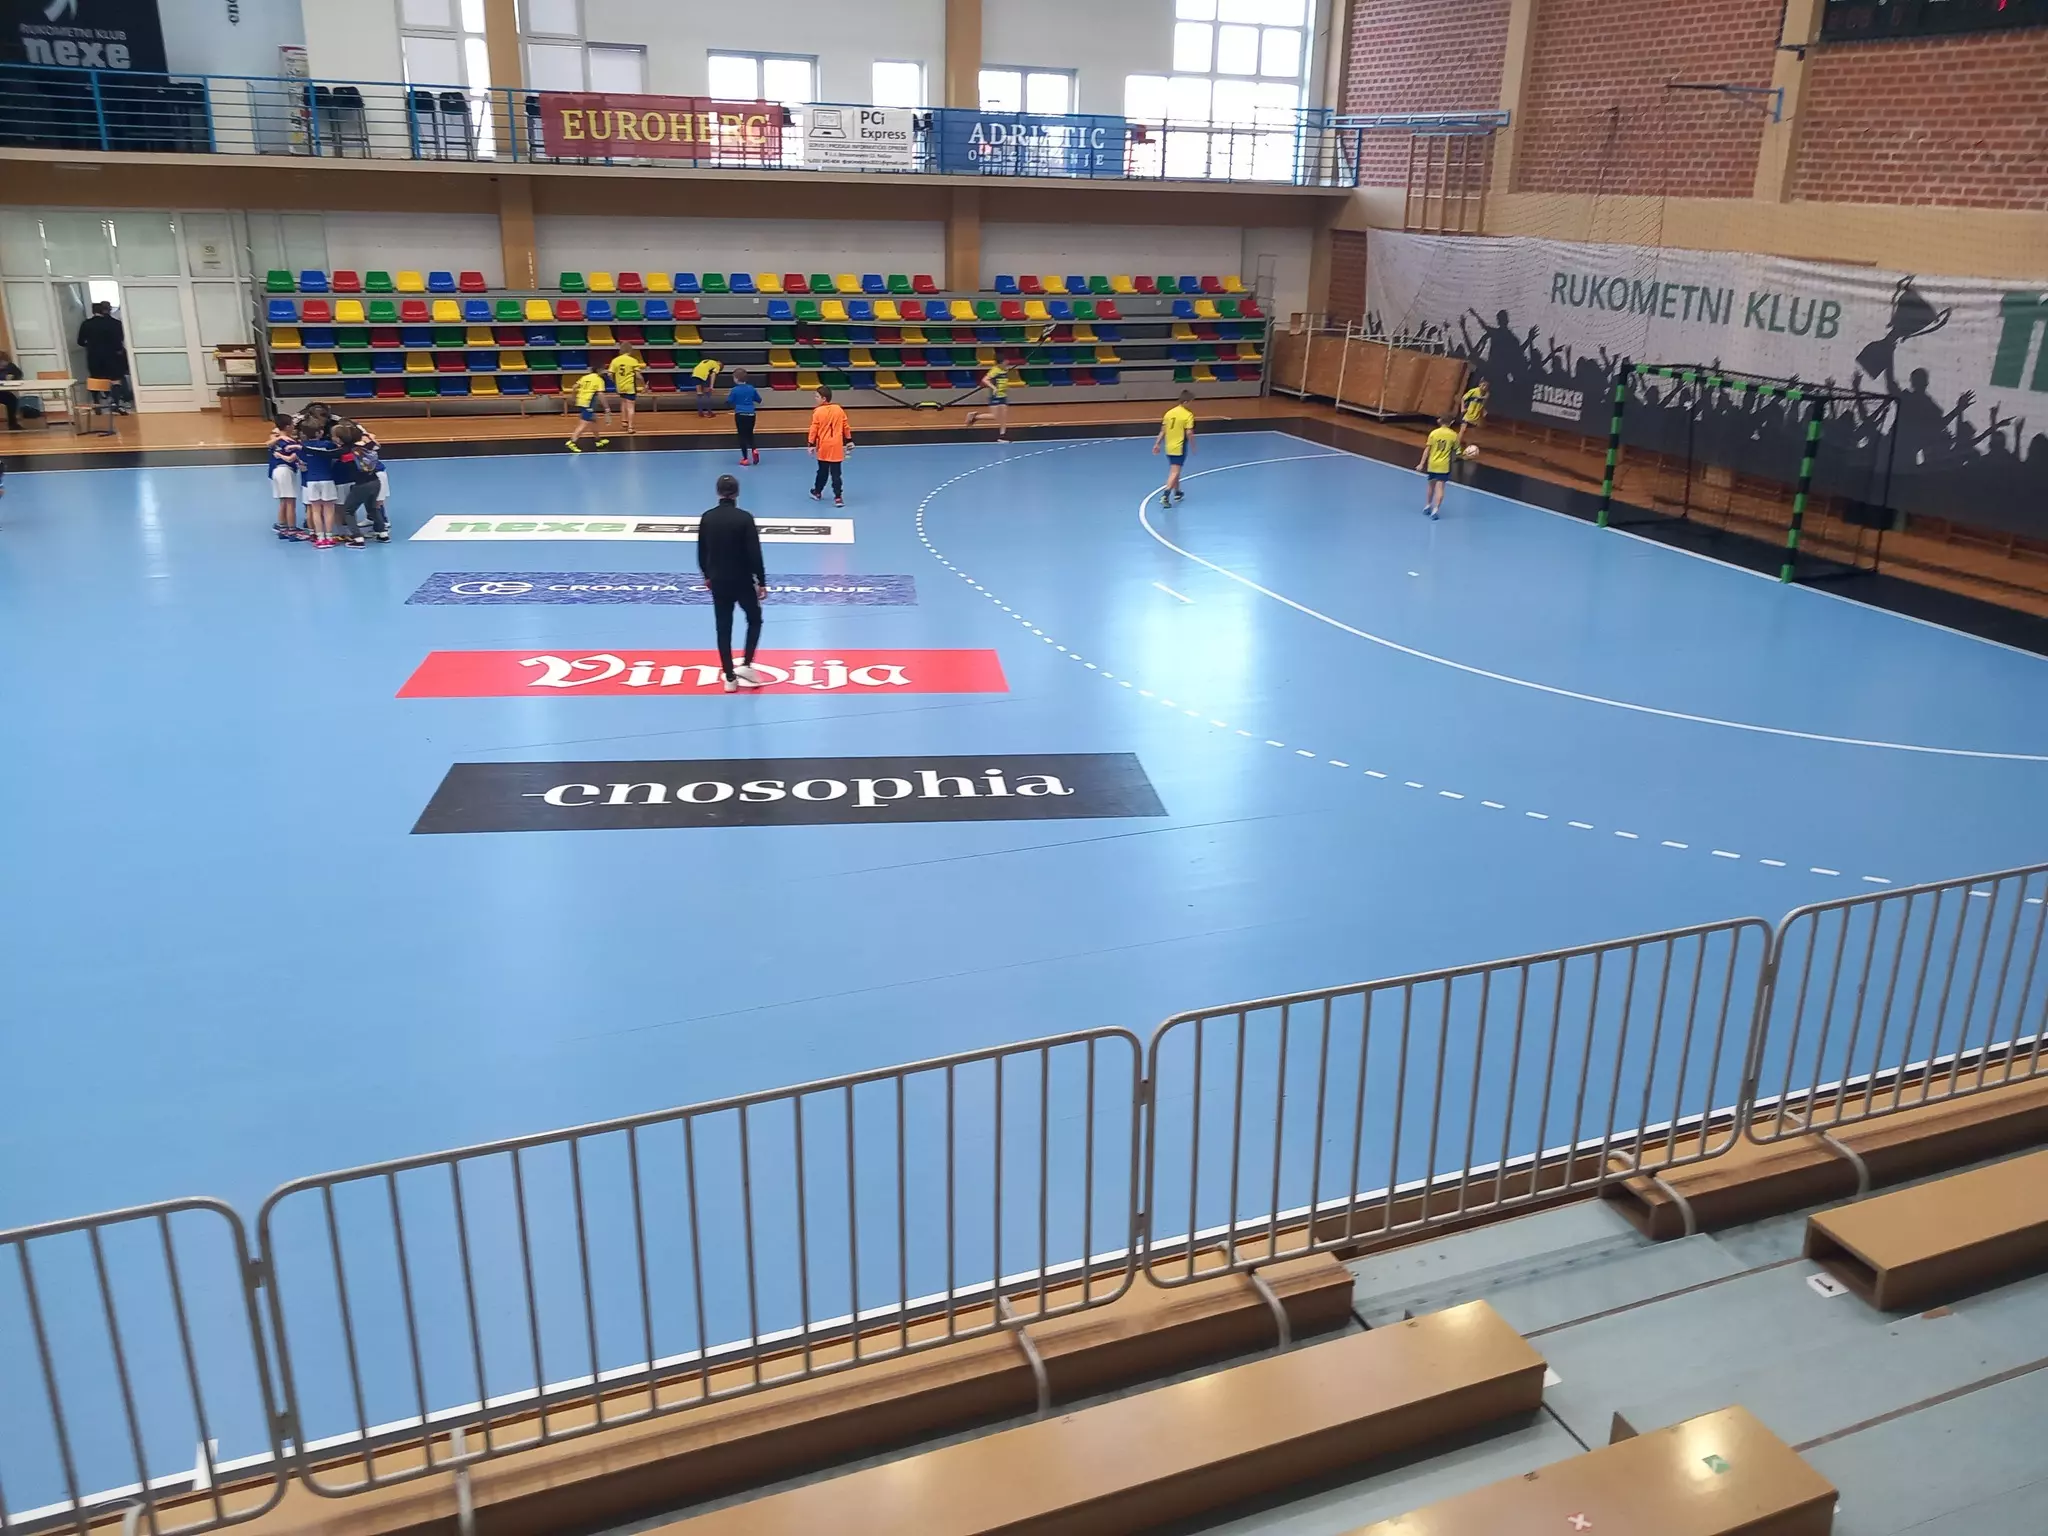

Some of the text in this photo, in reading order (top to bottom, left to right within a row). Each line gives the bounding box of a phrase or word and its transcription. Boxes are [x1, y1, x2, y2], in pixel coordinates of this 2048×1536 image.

[23, 38, 131, 69] nexe
[860, 110, 885, 125] PCi
[861, 127, 907, 141] Express
[1550, 271, 1842, 339] RUKOMETNI KLUB
[445, 521, 627, 533] nexe
[547, 584, 876, 593] CROATIA OURANJE
